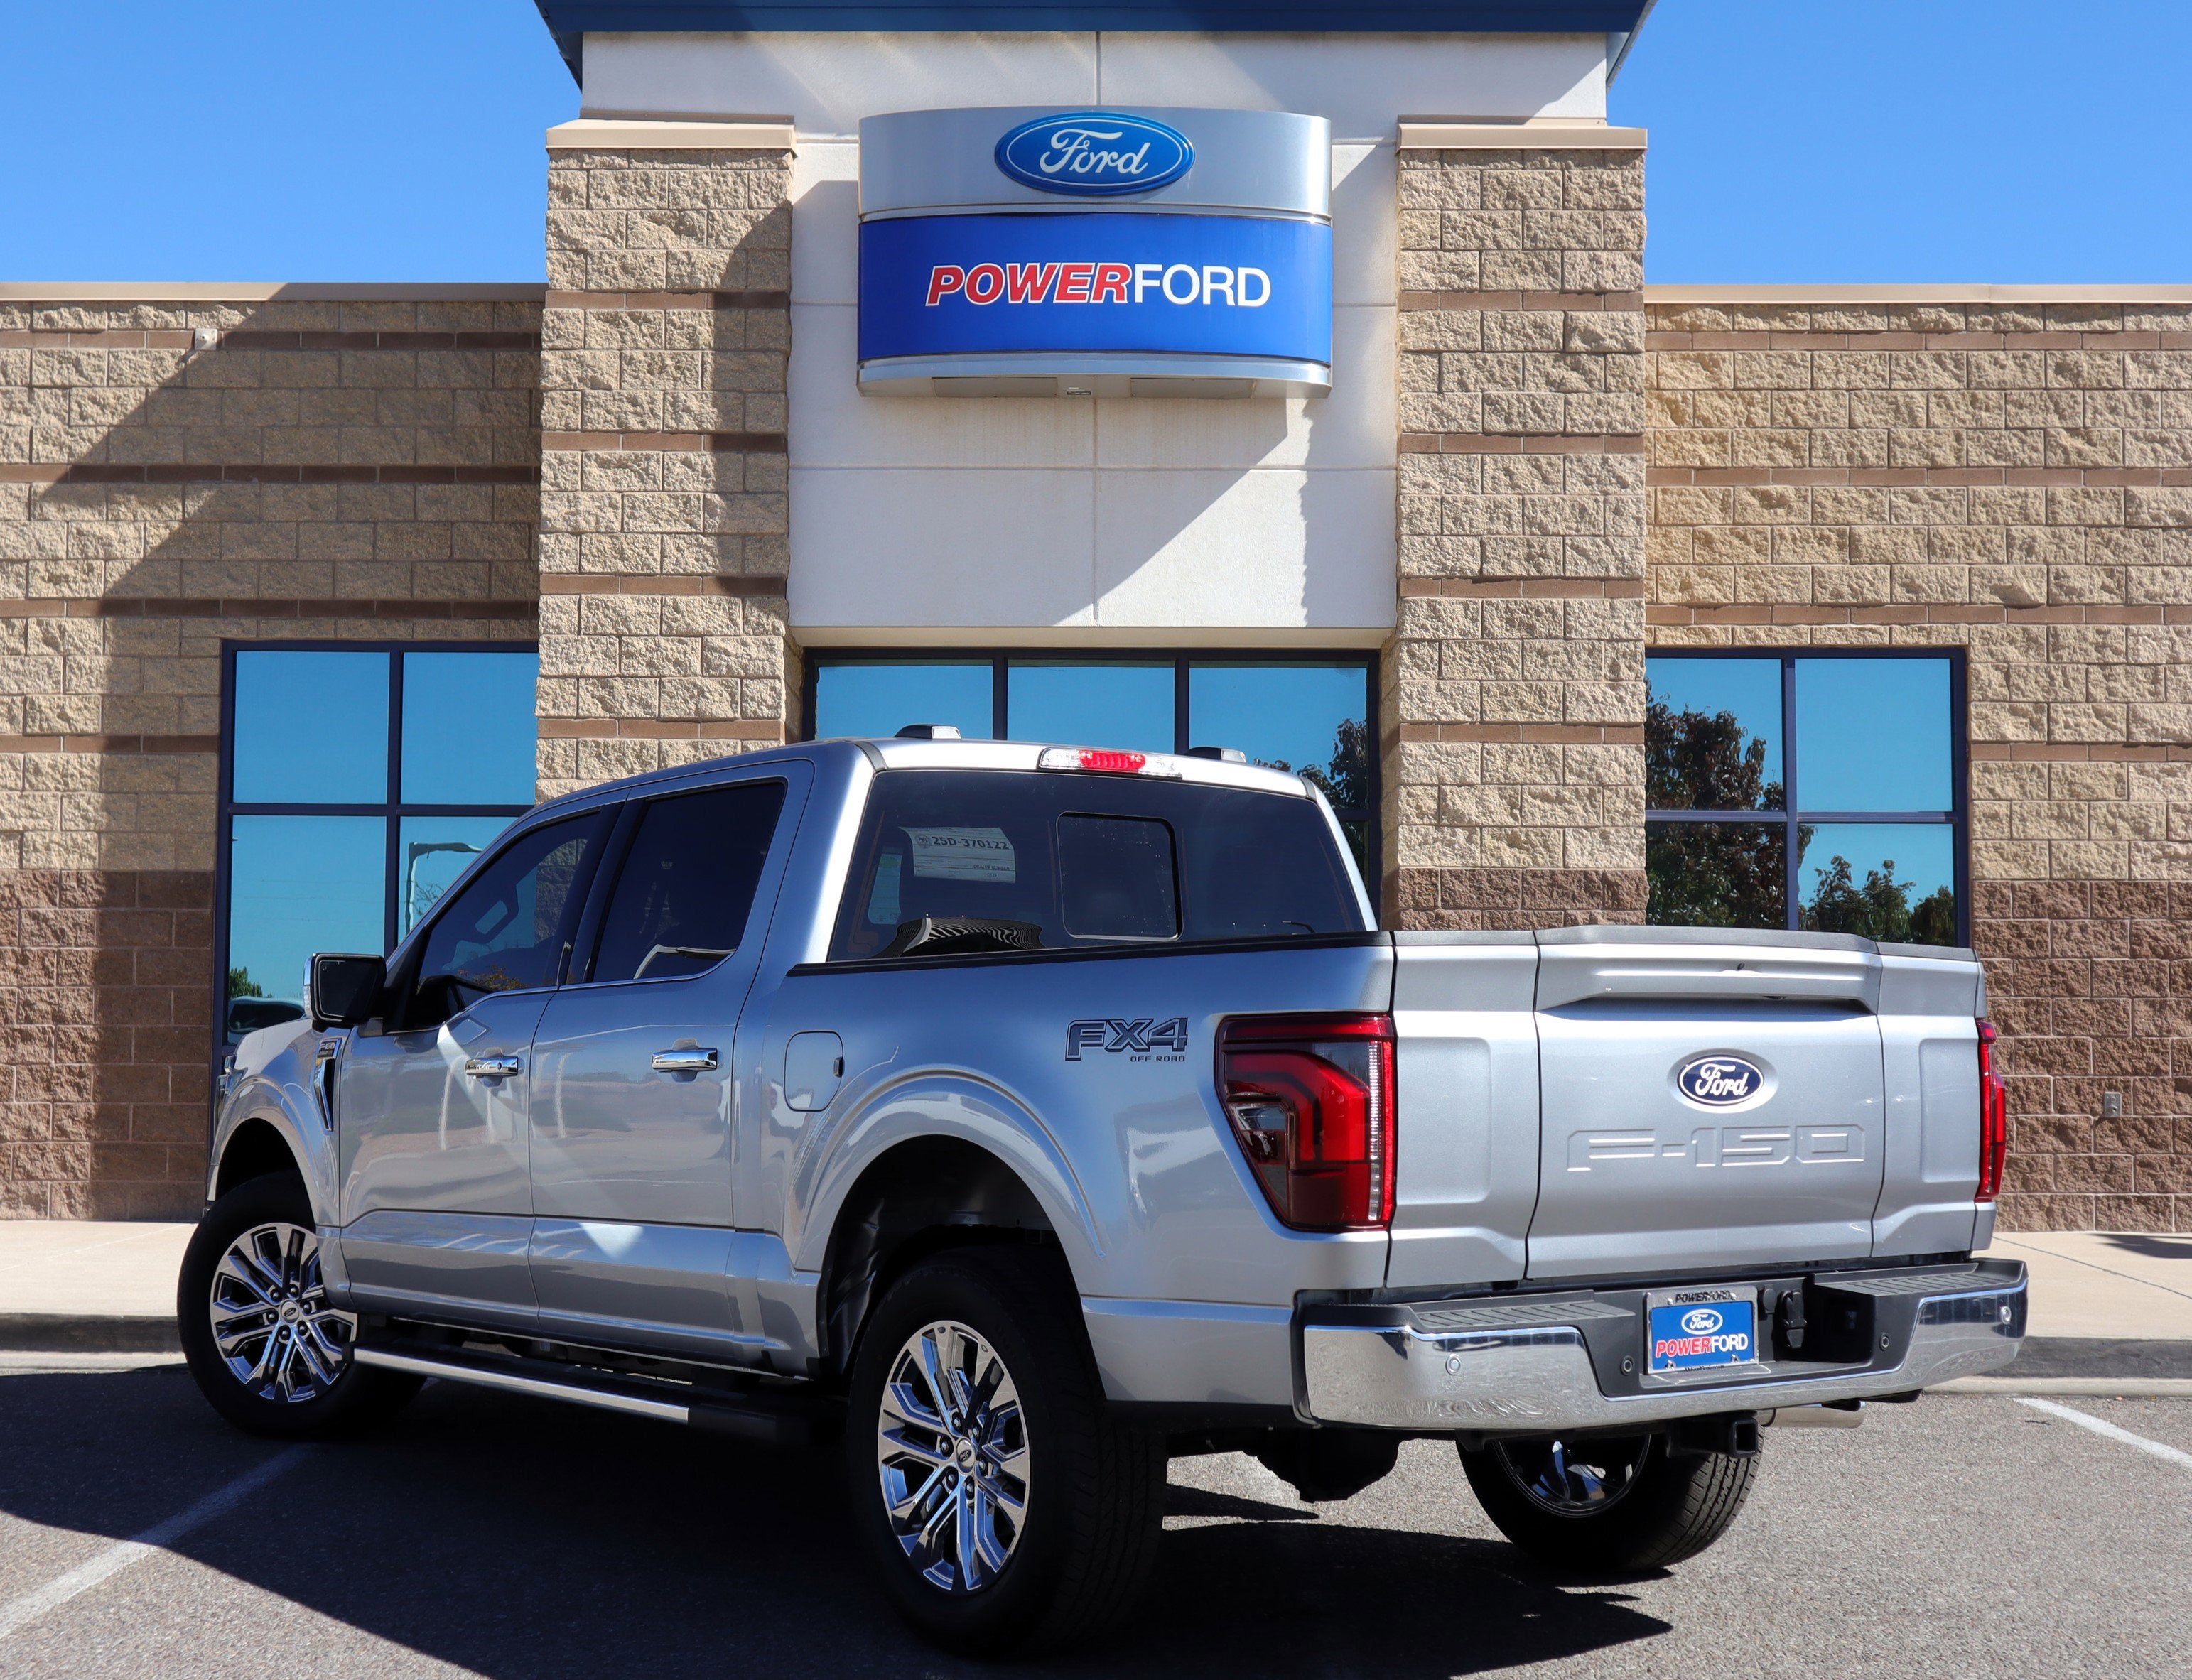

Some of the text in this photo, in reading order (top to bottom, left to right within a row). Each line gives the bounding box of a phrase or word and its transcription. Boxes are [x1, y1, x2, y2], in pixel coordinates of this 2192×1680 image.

[1039, 129, 1151, 175] Ford
[925, 262, 1271, 306] POWERFORD
[932, 836, 1010, 850] 25D-370122
[1065, 1017, 1188, 1061] FX4
[1695, 1063, 1749, 1096] Ford
[1567, 1124, 1866, 1171] F-150
[1690, 1314, 1715, 1329] Ford
[1656, 1333, 1749, 1358] POWERFORD
